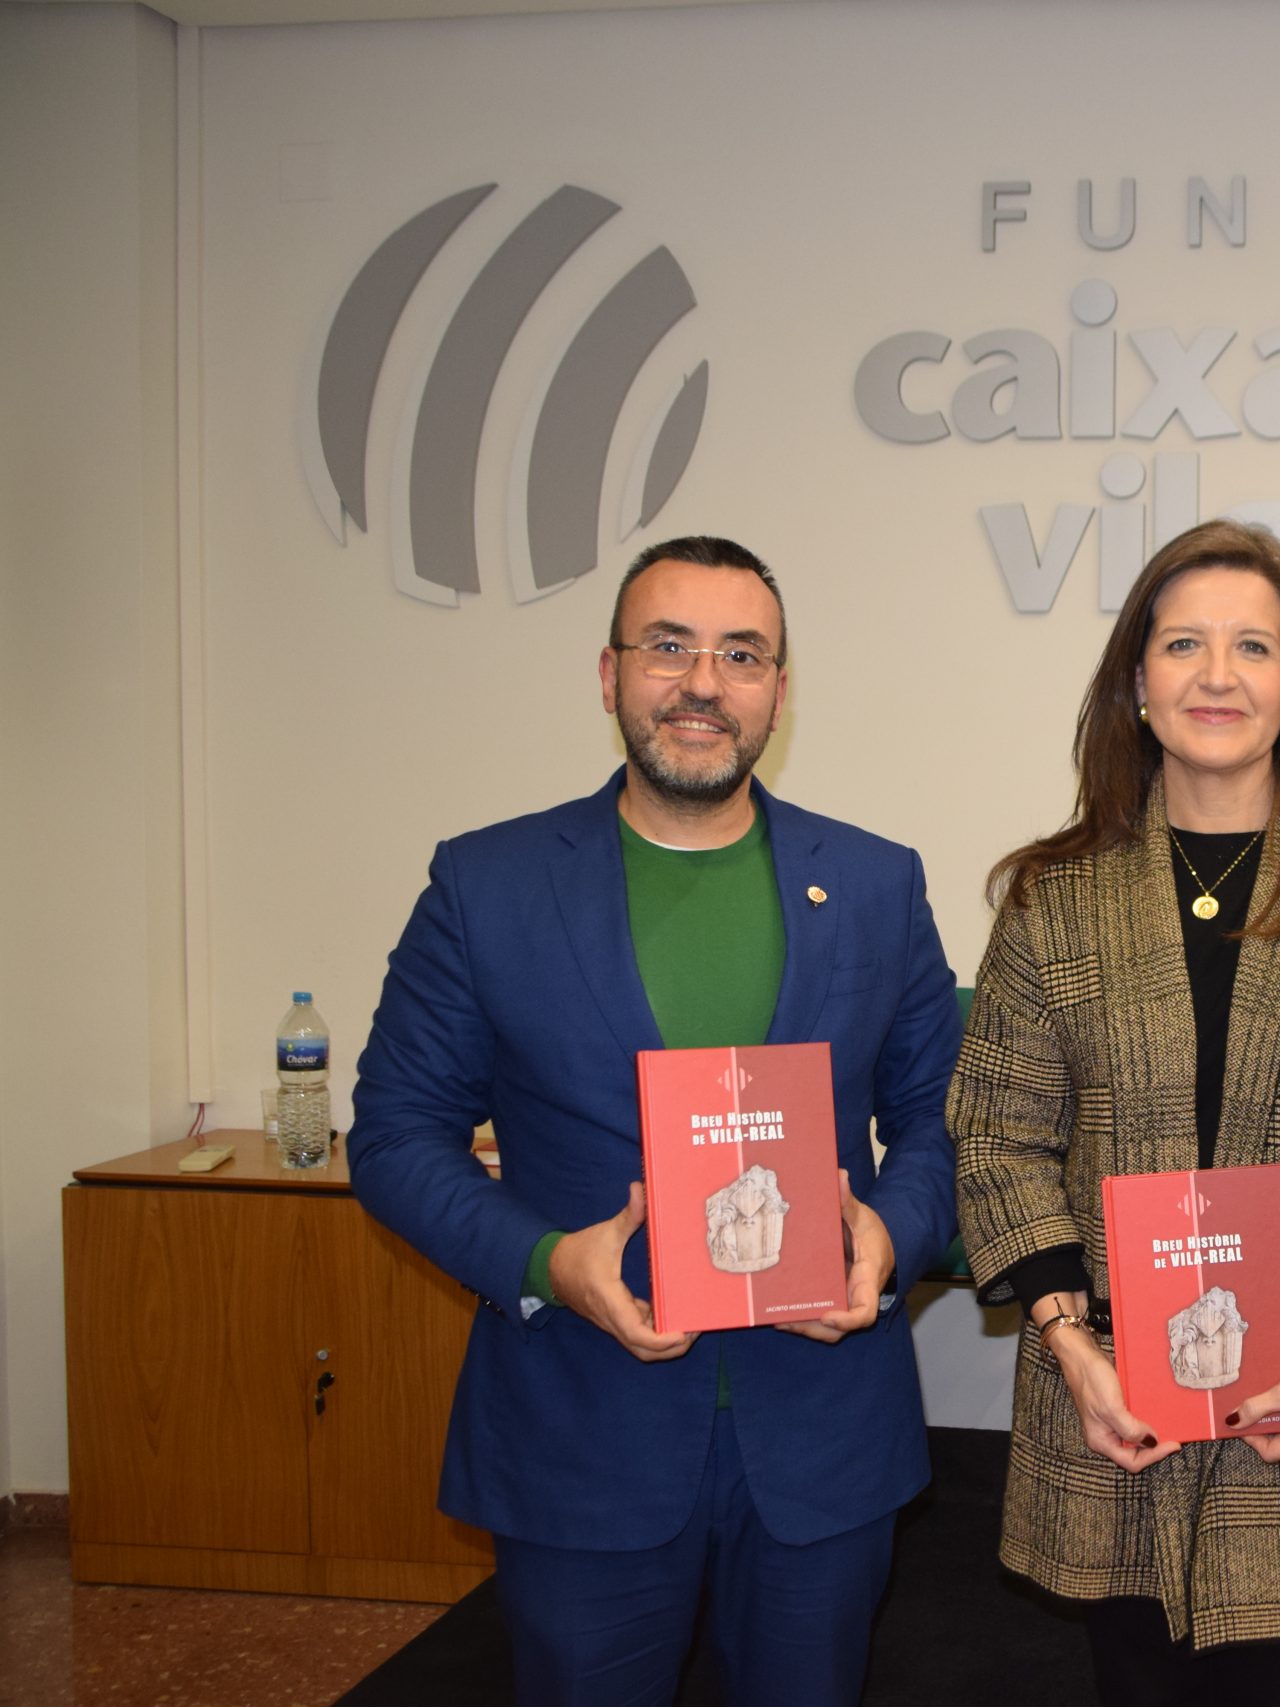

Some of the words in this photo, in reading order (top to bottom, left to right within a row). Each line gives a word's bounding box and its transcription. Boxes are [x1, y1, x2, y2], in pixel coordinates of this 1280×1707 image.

[691, 1114, 723, 1129] BREU
[727, 1110, 783, 1126] HISTÒRIA
[692, 1134, 706, 1146] DE
[709, 1124, 785, 1144] VILA-REAL
[1152, 1239, 1183, 1253] BREU
[1187, 1233, 1242, 1250] HISTÒRIA
[1154, 1258, 1167, 1269] DE
[1170, 1246, 1243, 1267] VILA-REAL
[765, 1305, 788, 1313] JACINTO
